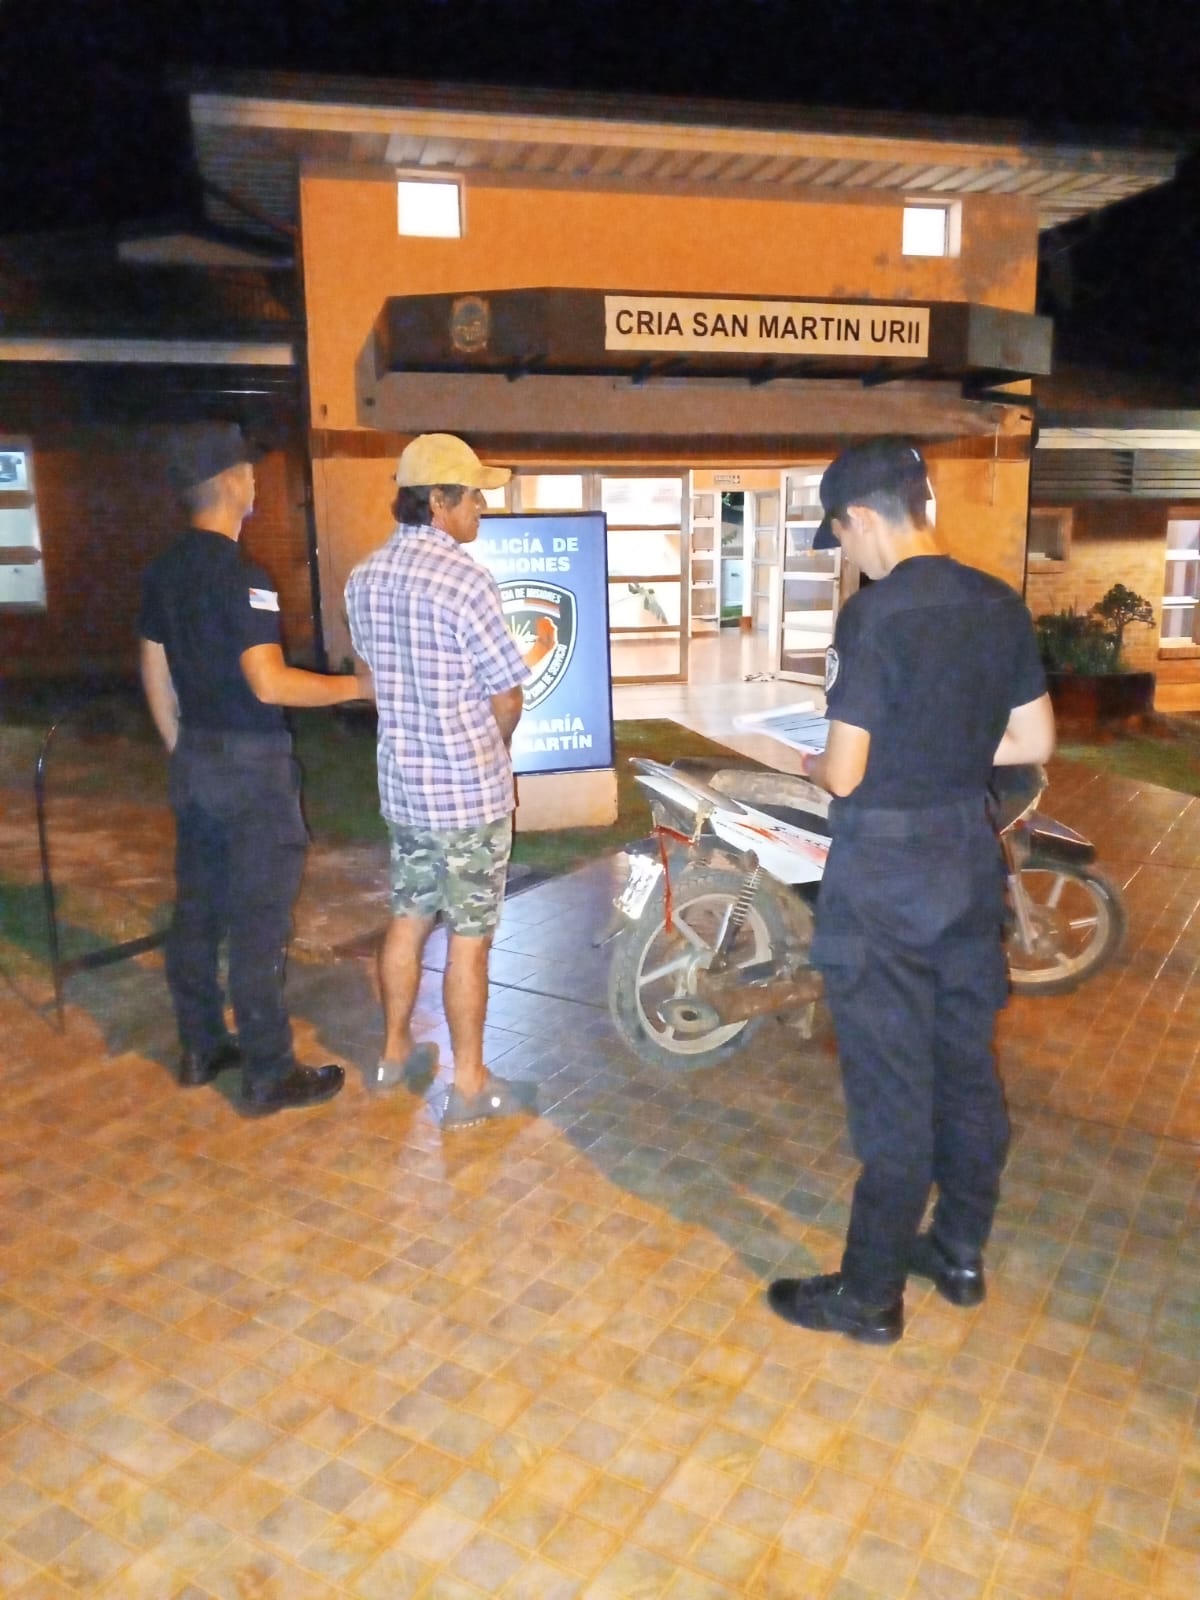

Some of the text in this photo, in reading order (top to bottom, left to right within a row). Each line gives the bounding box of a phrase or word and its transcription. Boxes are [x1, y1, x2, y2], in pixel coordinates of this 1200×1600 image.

[615, 309, 920, 344] CRIA SAN MARTIN URII
[553, 537, 579, 552] DE
